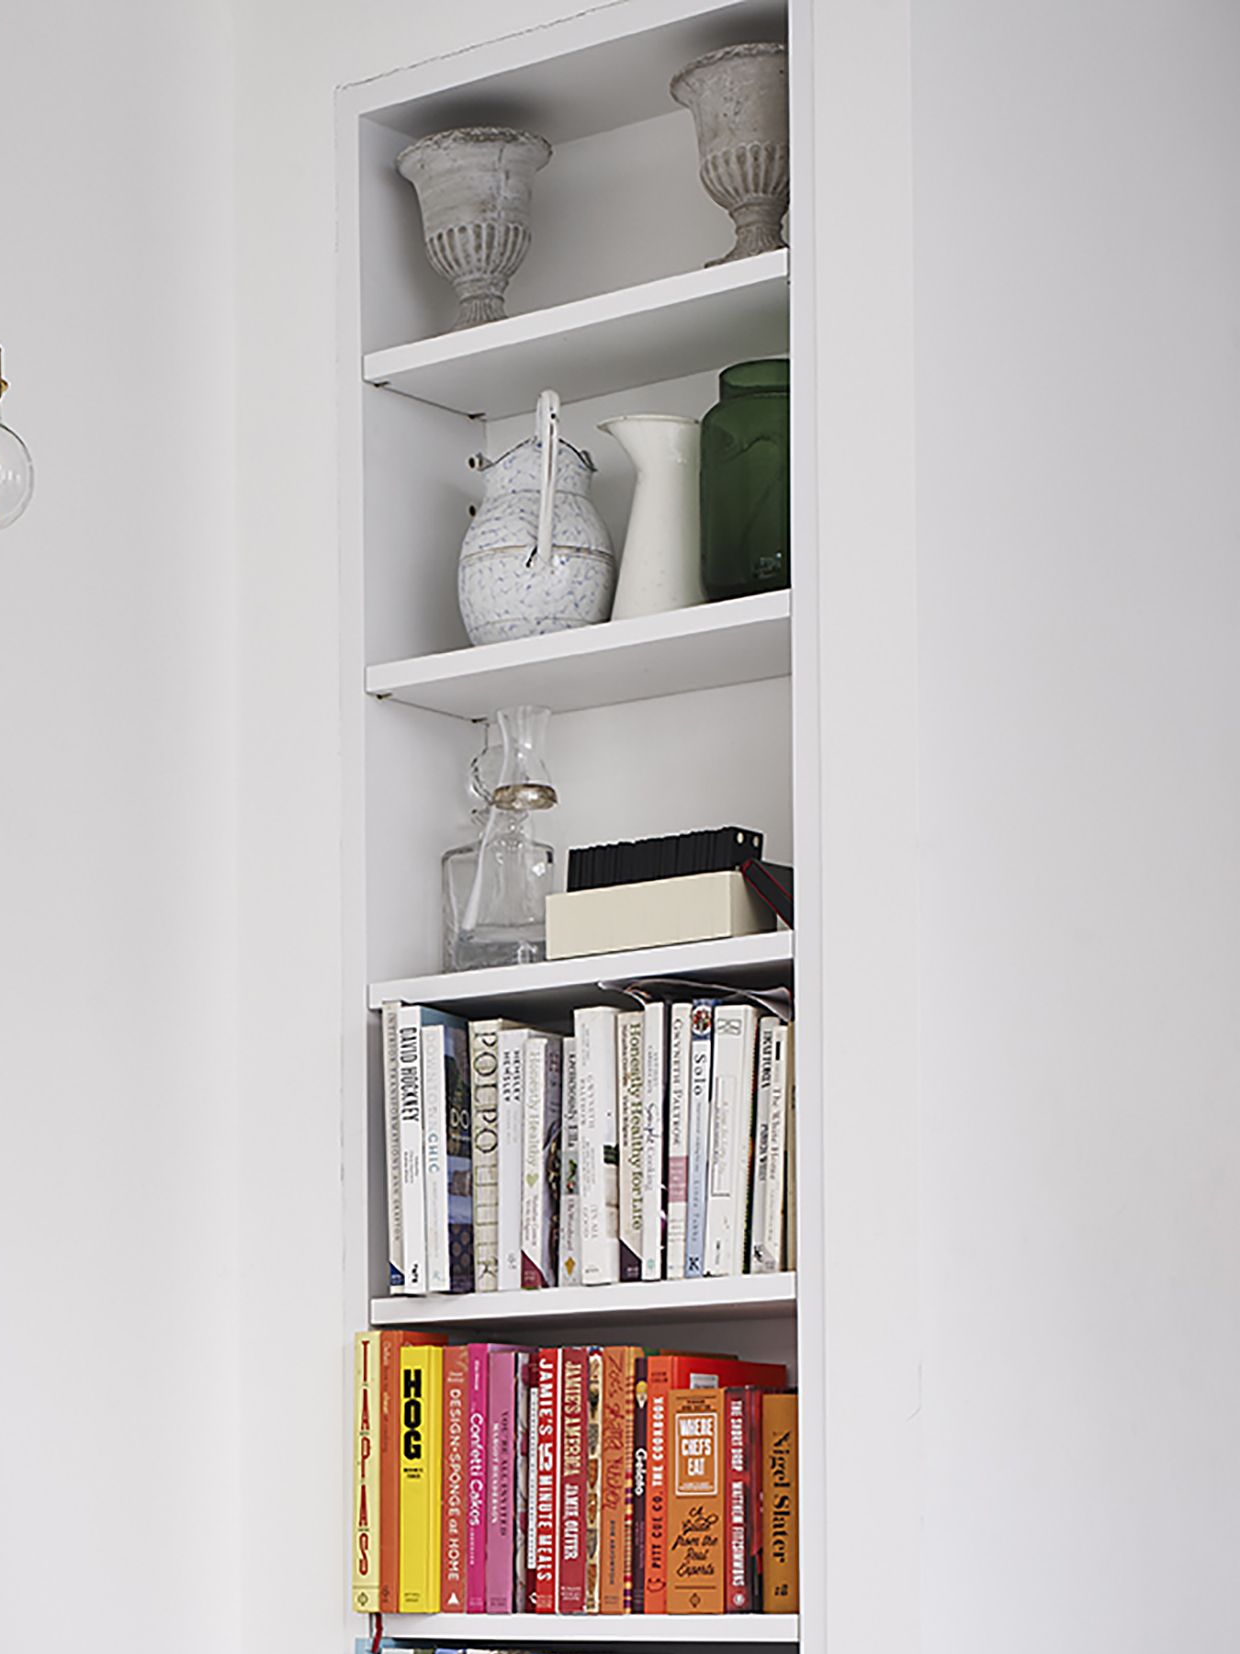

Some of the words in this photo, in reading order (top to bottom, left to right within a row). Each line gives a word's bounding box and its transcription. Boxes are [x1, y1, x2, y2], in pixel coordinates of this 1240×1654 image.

[400, 1027, 418, 1062] DAVID
[628, 1022, 642, 1098] Honestly
[672, 1017, 683, 1084] GWYNETH
[400, 1066, 420, 1122] HOCKNEY
[473, 1031, 499, 1155] POLPO
[525, 1051, 540, 1109] Honestly
[693, 1053, 707, 1096] Solo
[525, 1114, 542, 1166] Healthy
[629, 1101, 643, 1172] Healthy
[672, 1088, 683, 1146] PALTROW
[428, 1132, 440, 1173] CHIC
[631, 1174, 643, 1194] for
[632, 1197, 643, 1230] Life
[538, 1358, 554, 1435] JAMIE'S
[564, 1360, 582, 1413] JAMIE'S
[731, 1400, 743, 1416] THE
[403, 1367, 422, 1460] HOG
[653, 1397, 664, 1460] COOKBOOK
[679, 1417, 714, 1436] WHERE
[731, 1418, 743, 1446] SHORT
[359, 1340, 371, 1576] TAPAS
[468, 1411, 484, 1476] Confetti
[563, 1416, 581, 1476] AMERICA
[680, 1438, 712, 1456] CHEFS
[687, 1458, 705, 1476] EAT
[731, 1448, 744, 1472] DROP
[769, 1431, 791, 1488] Nigel
[634, 1447, 647, 1496] Gelato
[653, 1465, 664, 1487] THE
[469, 1479, 483, 1526] Cakes
[538, 1475, 552, 1529] MINUTE
[731, 1480, 744, 1523] MATTHEW
[564, 1519, 579, 1560] OLIVER
[772, 1494, 790, 1563] Slater
[537, 1534, 553, 1582] MEALS
